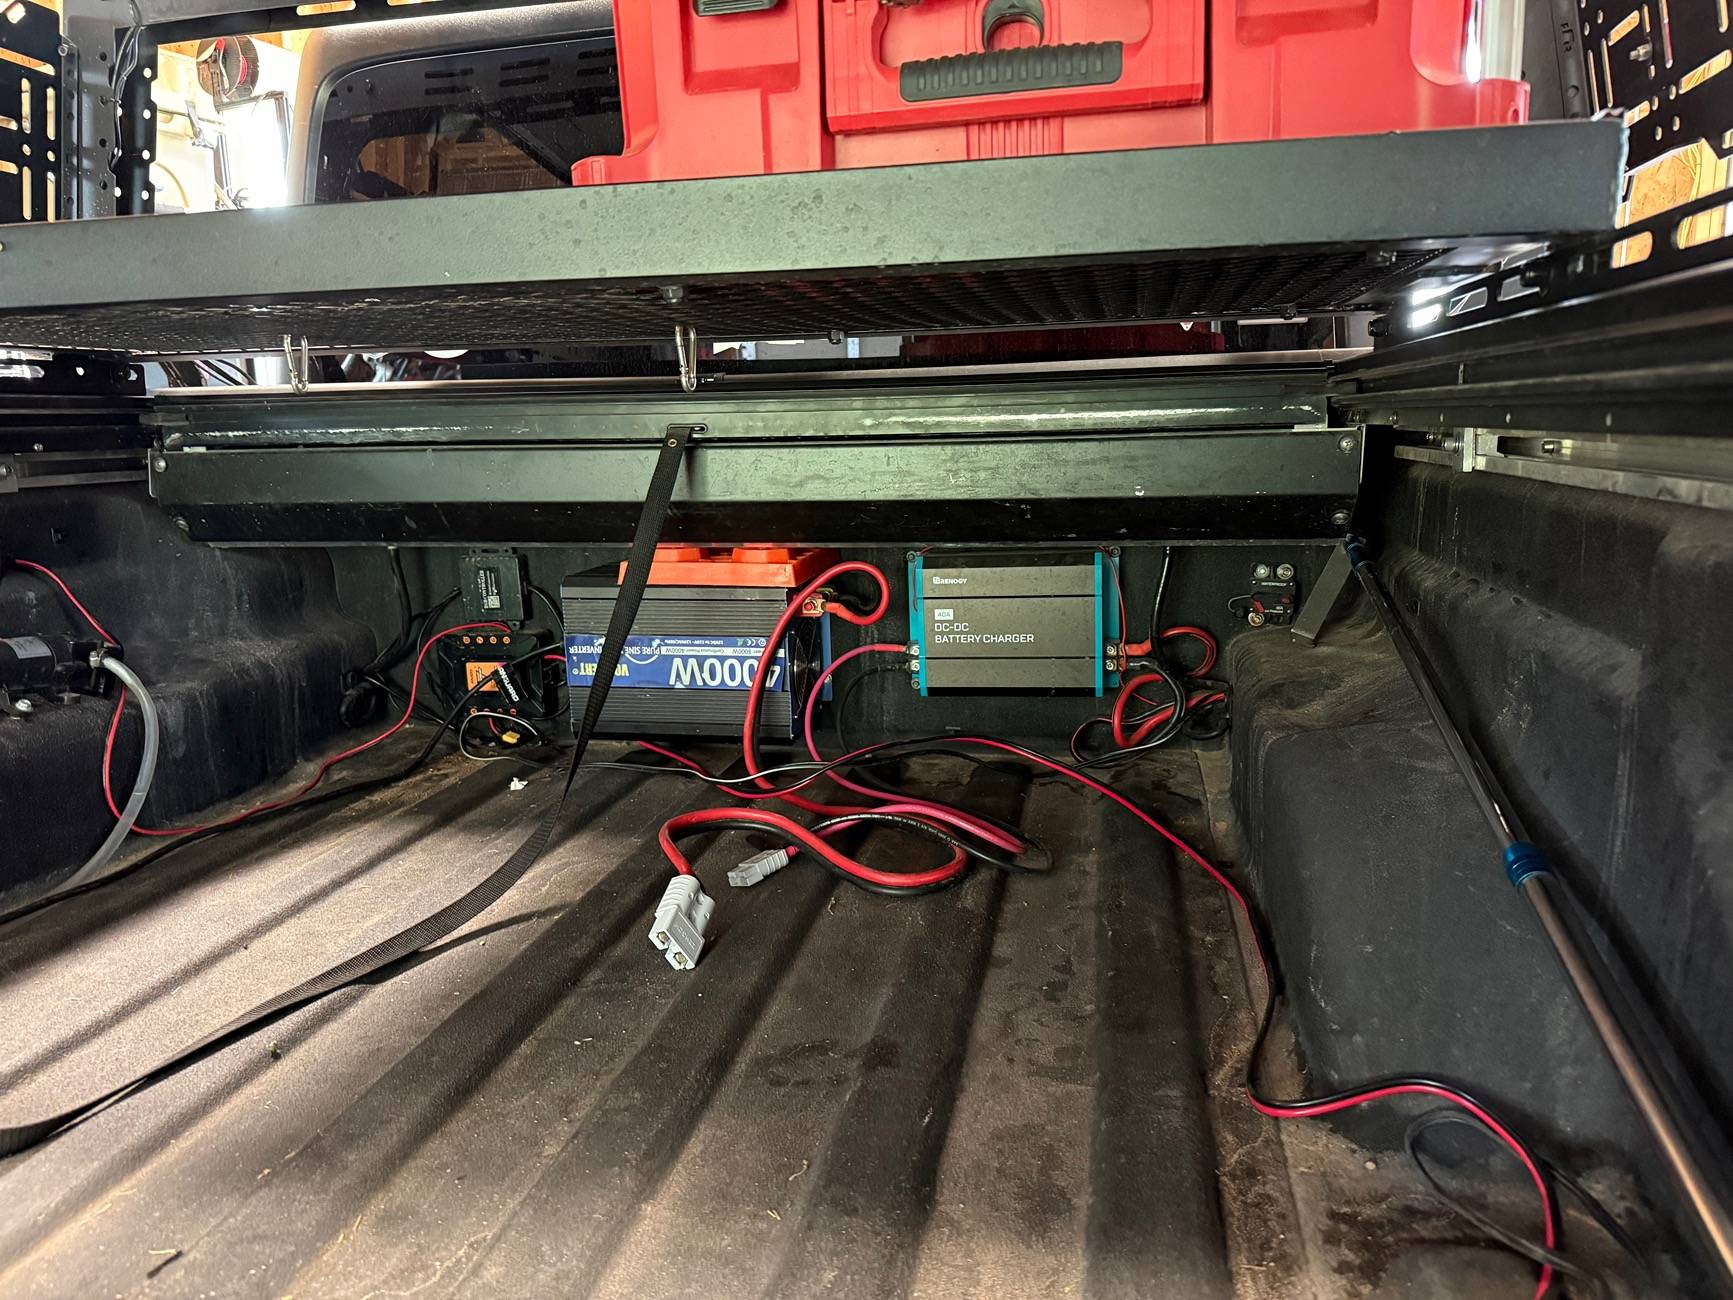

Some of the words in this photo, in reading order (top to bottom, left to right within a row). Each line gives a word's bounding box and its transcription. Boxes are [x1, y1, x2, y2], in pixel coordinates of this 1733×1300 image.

[934, 622, 969, 632] DC-DC
[934, 634, 982, 644] BATTERY
[982, 633, 1035, 644] CHARGER
[568, 645, 602, 654] INVERTER
[624, 646, 641, 655] SINE
[642, 646, 660, 655] PURE
